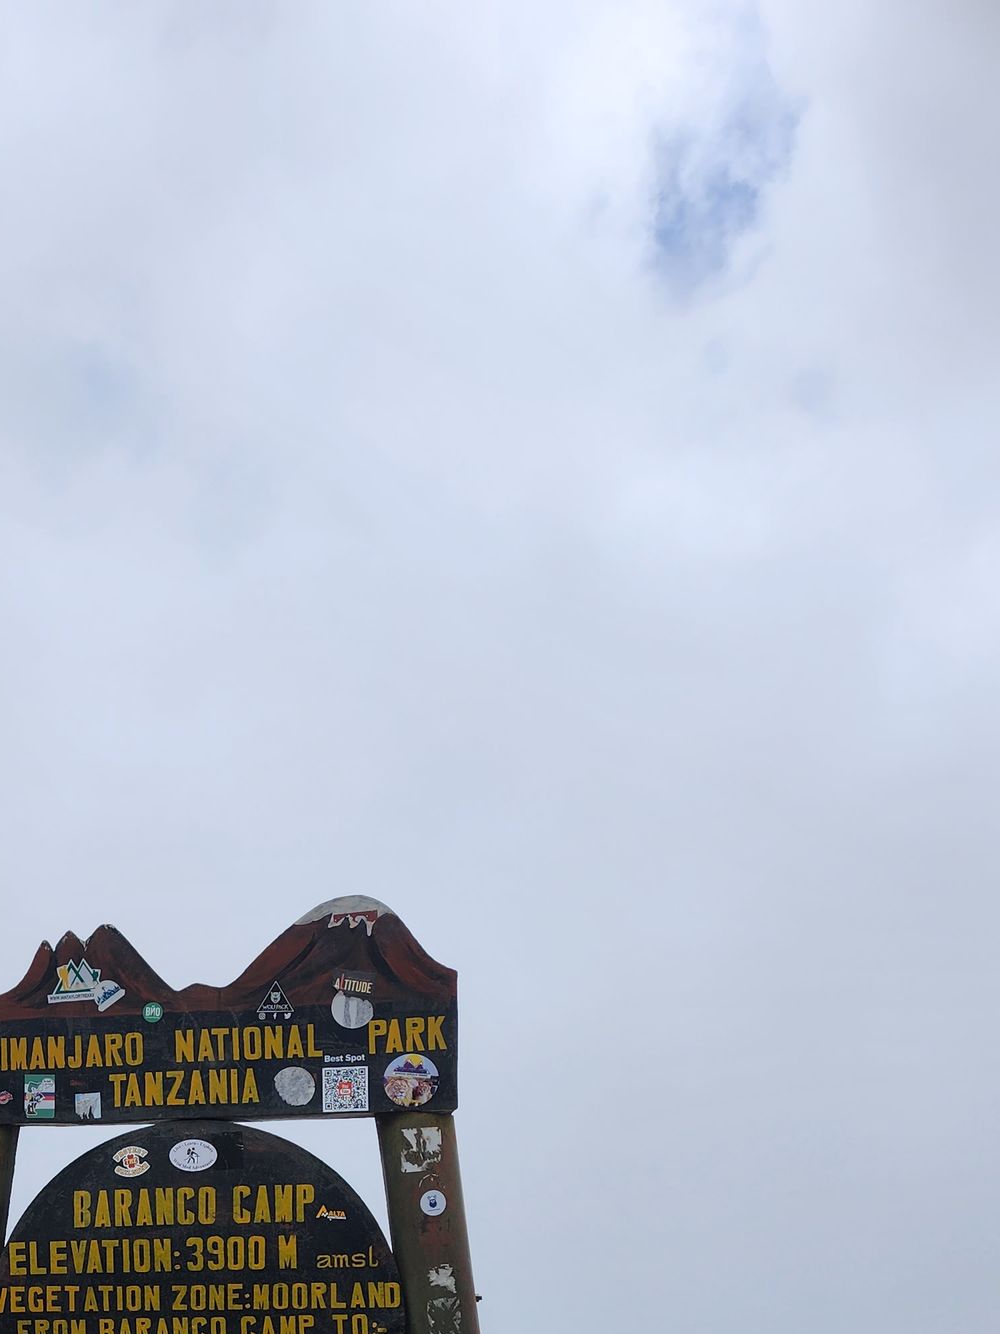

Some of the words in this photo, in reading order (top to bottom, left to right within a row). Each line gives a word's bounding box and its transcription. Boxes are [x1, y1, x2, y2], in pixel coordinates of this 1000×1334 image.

[174, 1024, 323, 1062] NATIONAL
[368, 1015, 448, 1055] PARK
[324, 1055, 344, 1063] Best
[345, 1054, 366, 1064] Spot
[109, 1068, 260, 1107] TANZANIA
[73, 1186, 217, 1228] BARANCO
[232, 1184, 315, 1224] CAMP
[278, 1235, 297, 1270] M
[316, 1245, 379, 1269] amsl
